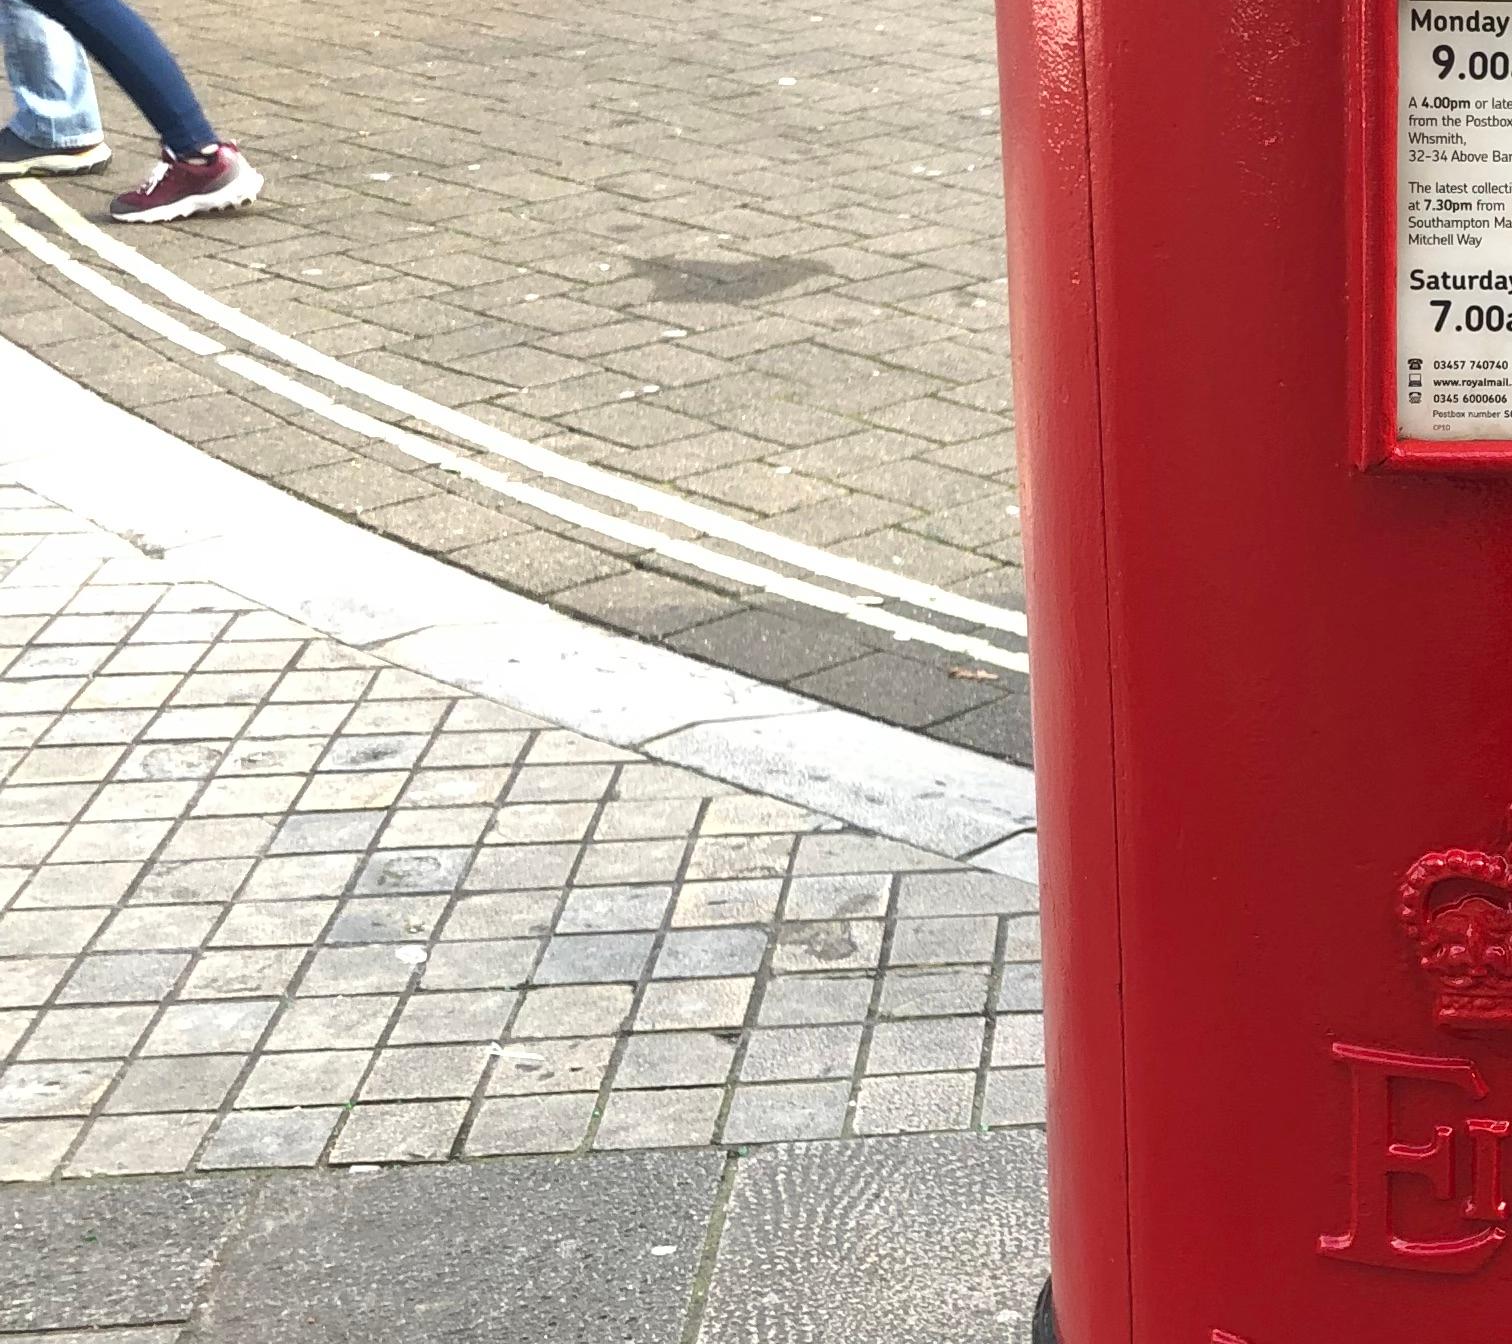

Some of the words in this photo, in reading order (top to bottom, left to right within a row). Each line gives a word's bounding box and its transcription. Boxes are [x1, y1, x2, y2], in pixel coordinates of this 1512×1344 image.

[1410, 7, 1511, 38] Monday
[1408, 96, 1418, 109] A
[1420, 95, 1471, 112] 4.00pm
[1474, 99, 1489, 110] or
[1408, 113, 1438, 127] from
[1441, 114, 1462, 127] the
[1407, 131, 1467, 147] Whsmith,
[1408, 149, 1448, 163] 32-34
[1450, 149, 1489, 163] Above
[1407, 180, 1432, 194] The
[1435, 181, 1469, 194] latest
[1407, 199, 1421, 212] at
[1423, 198, 1473, 214] 7.30pm
[1476, 198, 1506, 212] from
[1405, 213, 1490, 231] Southampton
[1408, 232, 1454, 246] Mitchell
[1456, 233, 1483, 249] Way
[1433, 359, 1467, 370] 03457
[1469, 359, 1509, 371] 740740
[1433, 393, 1459, 404] 0345
[1462, 393, 1508, 404] 6000606
[1432, 409, 1466, 419] Postbox
[1467, 409, 1502, 419] number
